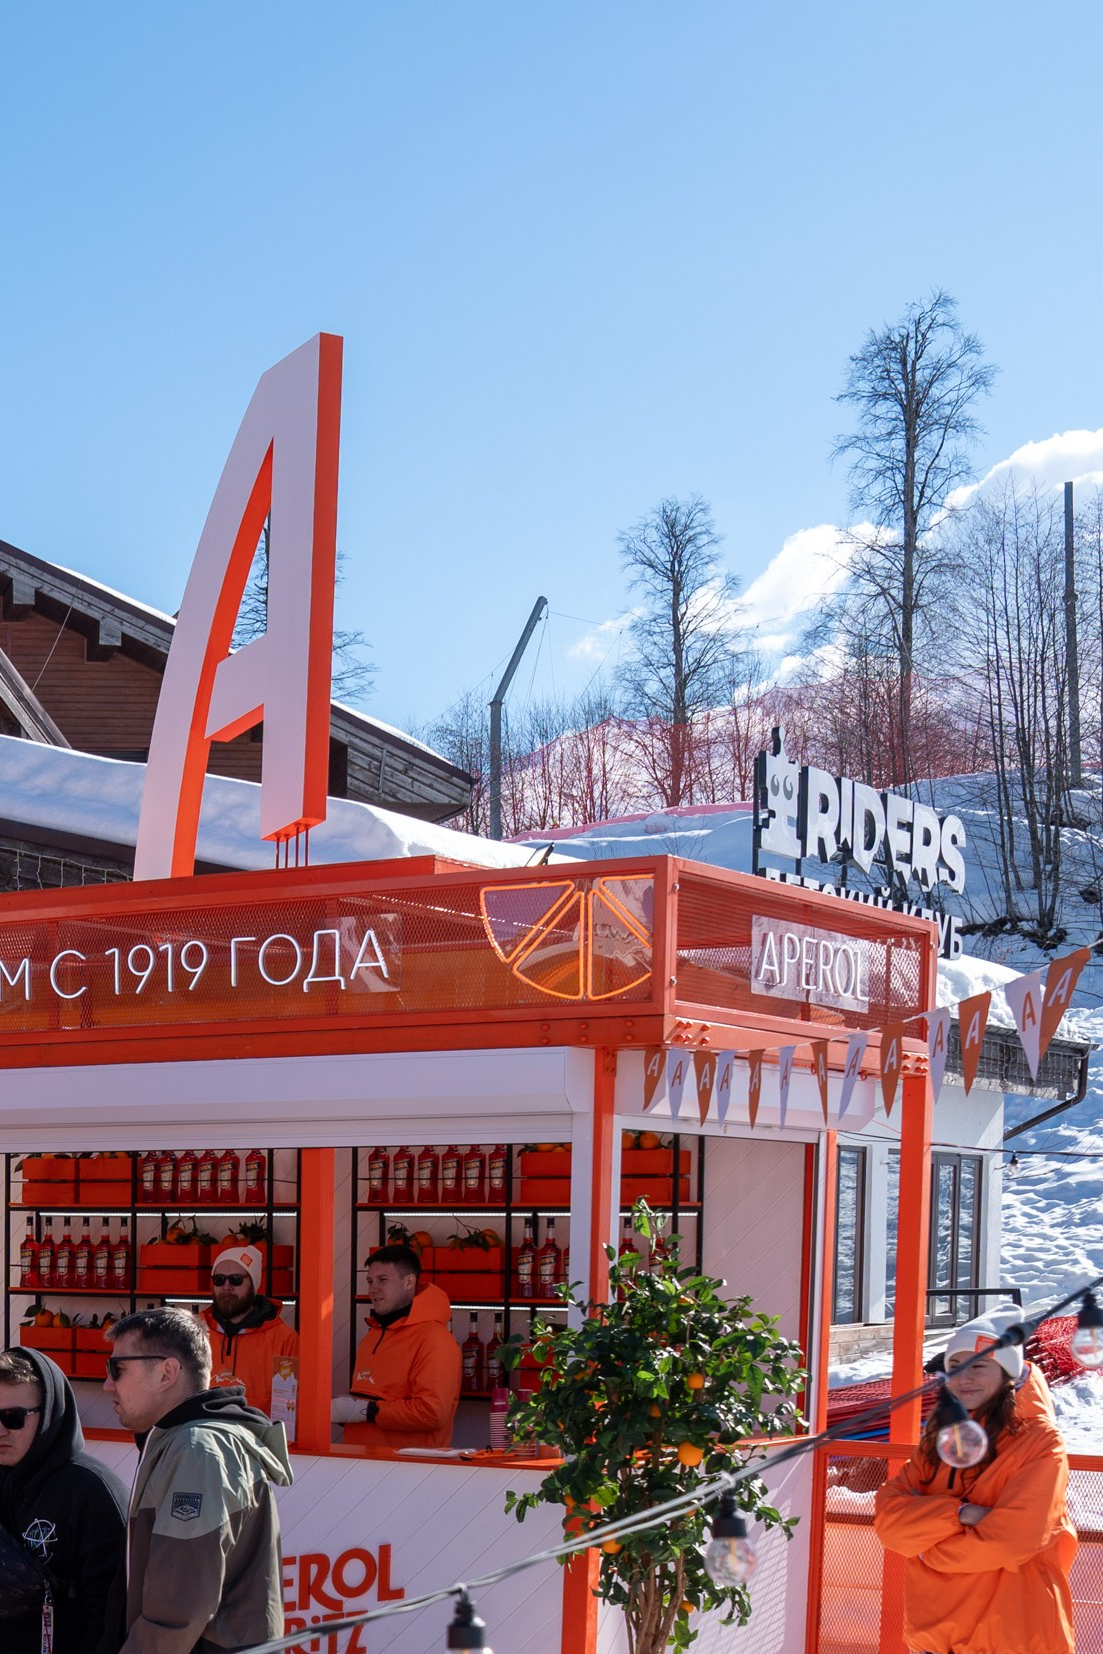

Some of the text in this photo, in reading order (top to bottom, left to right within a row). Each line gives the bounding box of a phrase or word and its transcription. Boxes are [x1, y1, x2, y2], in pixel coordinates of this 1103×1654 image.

[801, 766, 966, 895] RIDERS
[49, 949, 88, 999] С
[106, 939, 210, 996] 1919
[230, 928, 391, 992] ГОДА
[757, 931, 869, 1001] APEROL
[1051, 967, 1072, 1006] A
[965, 1010, 982, 1049] A
[1021, 996, 1038, 1033] A
[884, 1039, 897, 1075] A
[932, 1020, 945, 1059] A
[647, 1053, 660, 1077] A
[671, 1061, 684, 1088] A
[699, 1062, 711, 1090] A
[720, 1063, 732, 1091] A
[751, 1062, 761, 1090] A
[780, 1063, 790, 1088] A
[818, 1053, 827, 1086] A
[846, 1046, 861, 1078] A
[282, 1544, 405, 1613] EROL
